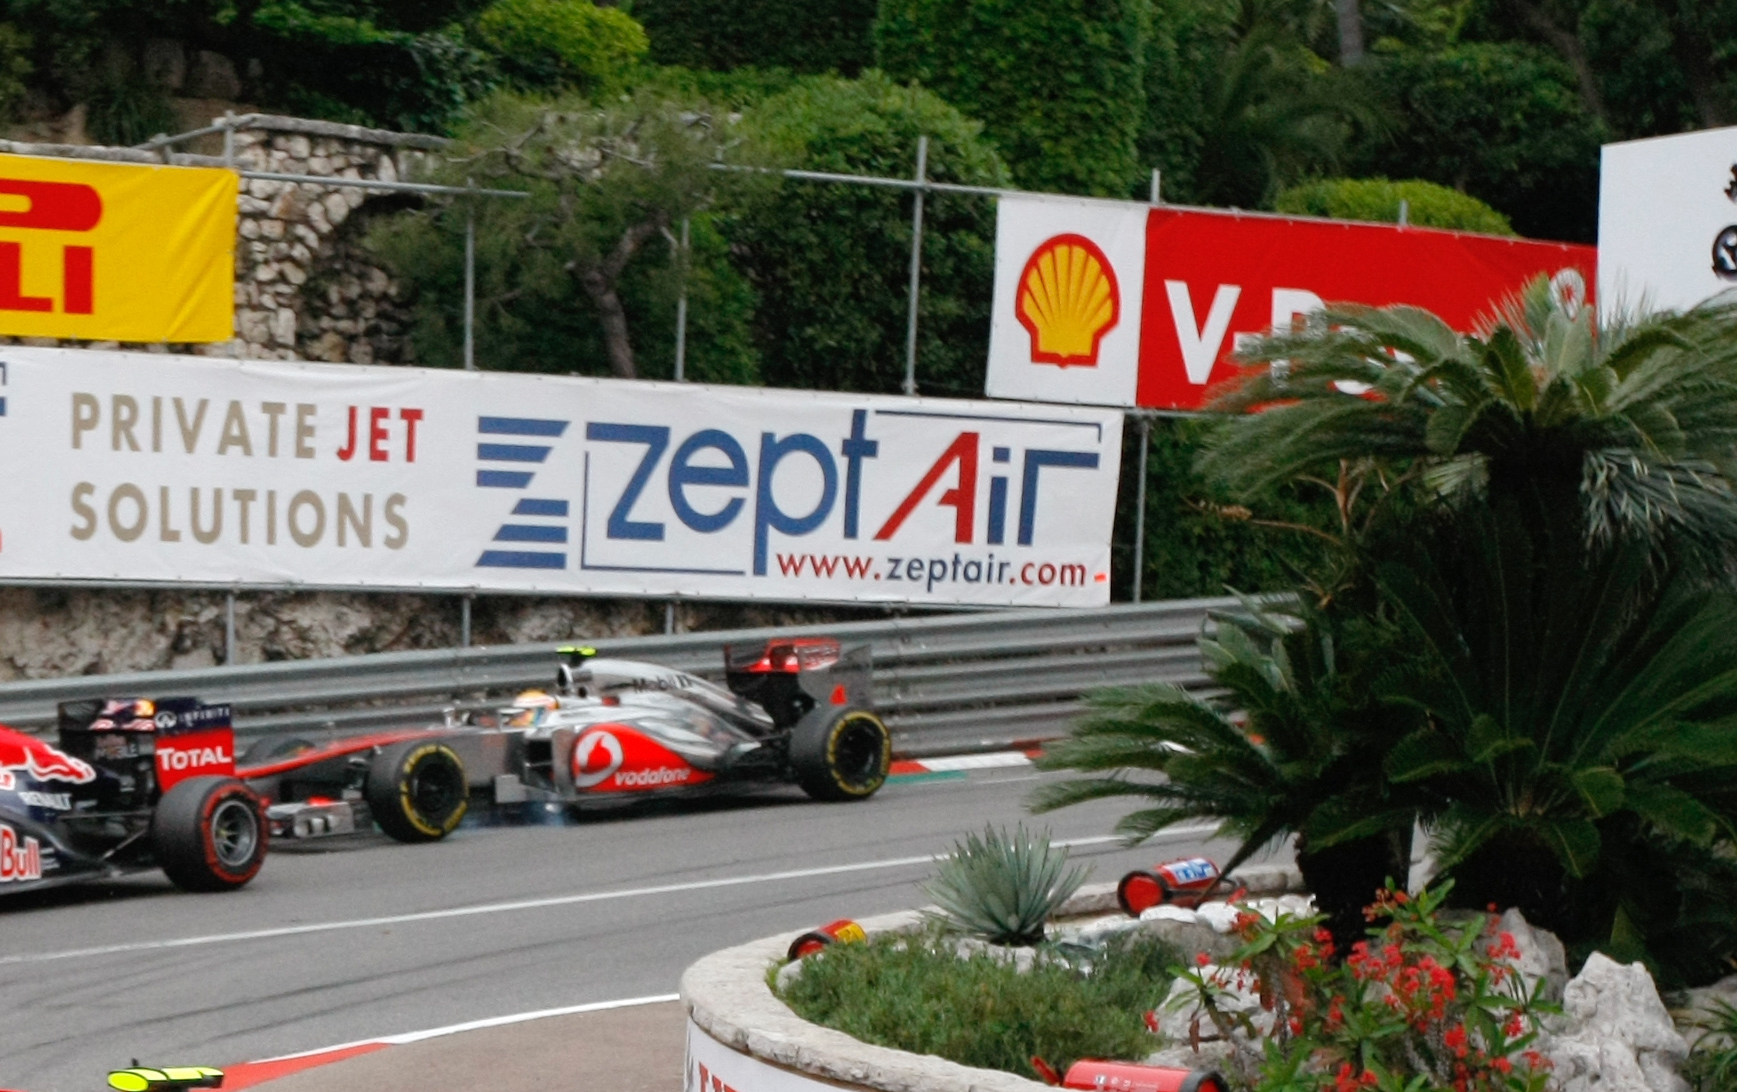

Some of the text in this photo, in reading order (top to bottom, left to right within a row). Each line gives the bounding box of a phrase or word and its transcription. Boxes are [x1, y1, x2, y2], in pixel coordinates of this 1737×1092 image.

[71, 392, 424, 463] PRIVATE JET
[69, 481, 410, 550] SOLUTIONS
[776, 551, 1087, 592] www.zeptair.com
[157, 746, 232, 771] TOTAL
[615, 766, 691, 786] vodafone
